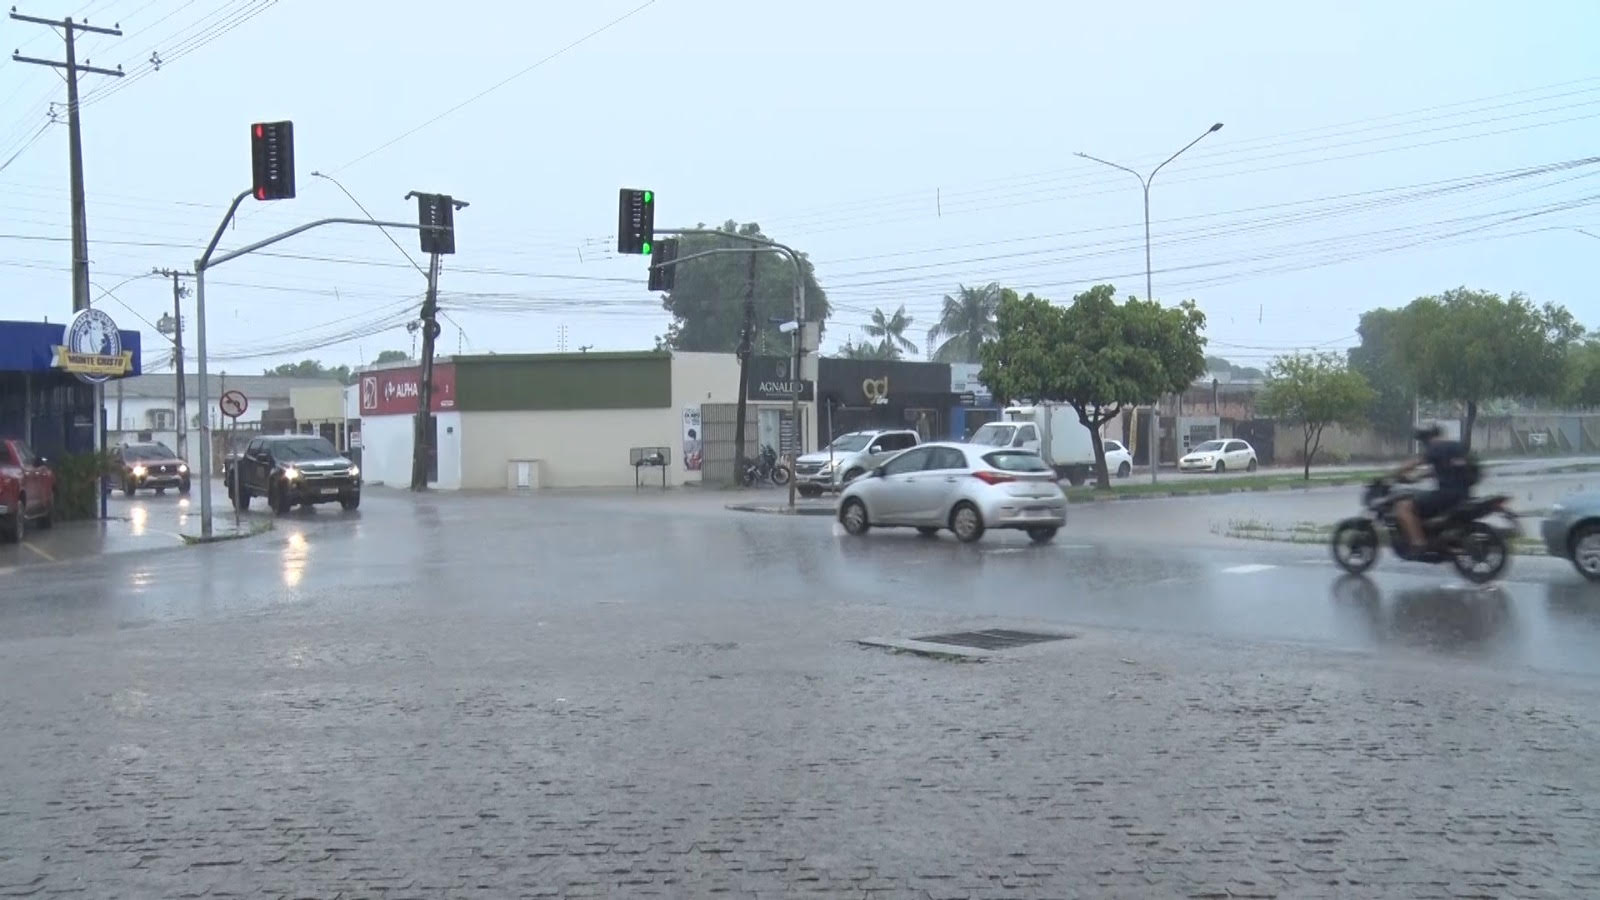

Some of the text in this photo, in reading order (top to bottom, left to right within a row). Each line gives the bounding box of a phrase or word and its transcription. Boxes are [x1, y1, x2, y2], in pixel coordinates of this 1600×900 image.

[68, 355, 124, 367] MONTE CRISTO
[396, 382, 418, 398] ALPHA
